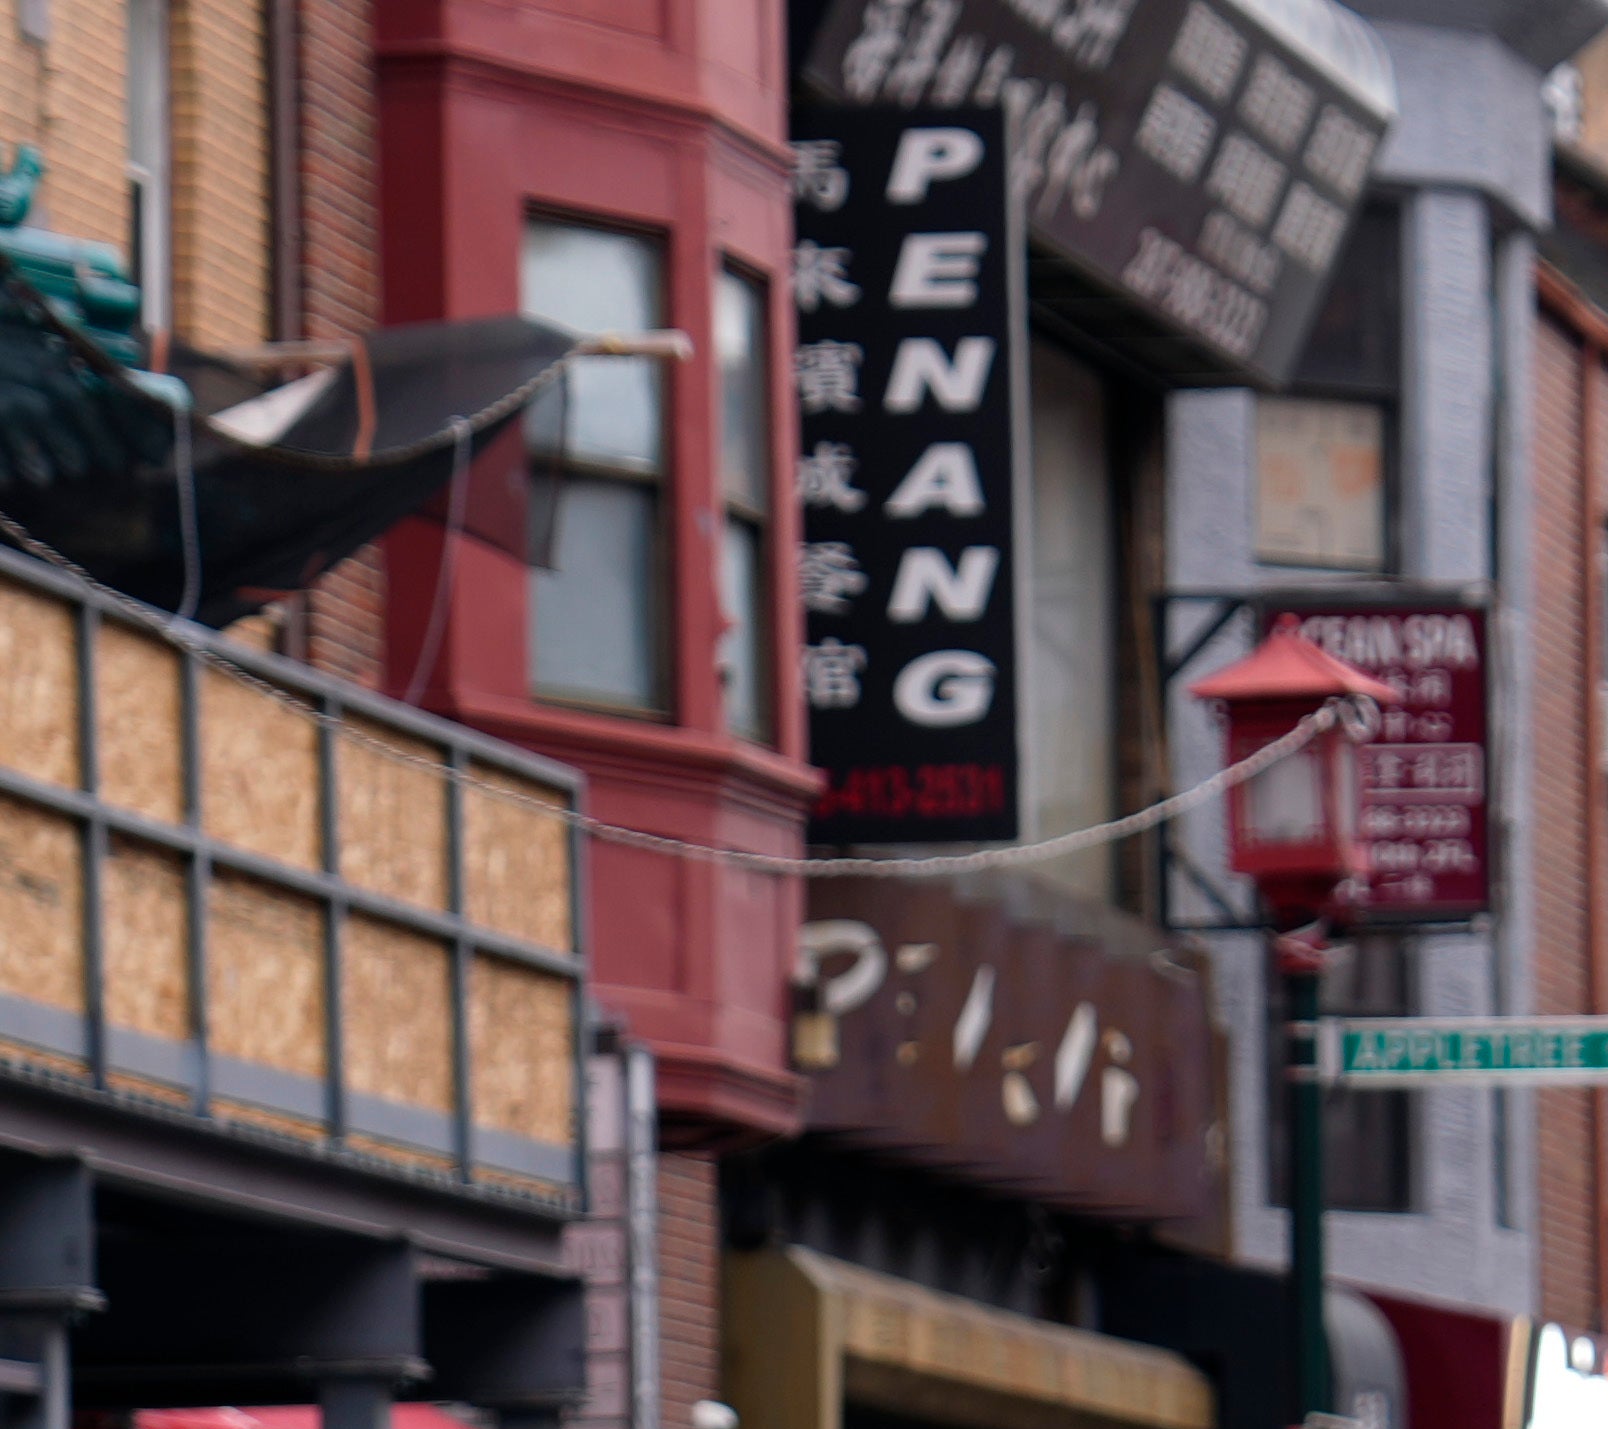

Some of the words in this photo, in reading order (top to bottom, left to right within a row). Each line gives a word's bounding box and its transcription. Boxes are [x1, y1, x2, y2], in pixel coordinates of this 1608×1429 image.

[884, 126, 999, 728] PENANG
[1303, 615, 1401, 668] CEAN
[1351, 1029, 1586, 1070] APPLETREE
